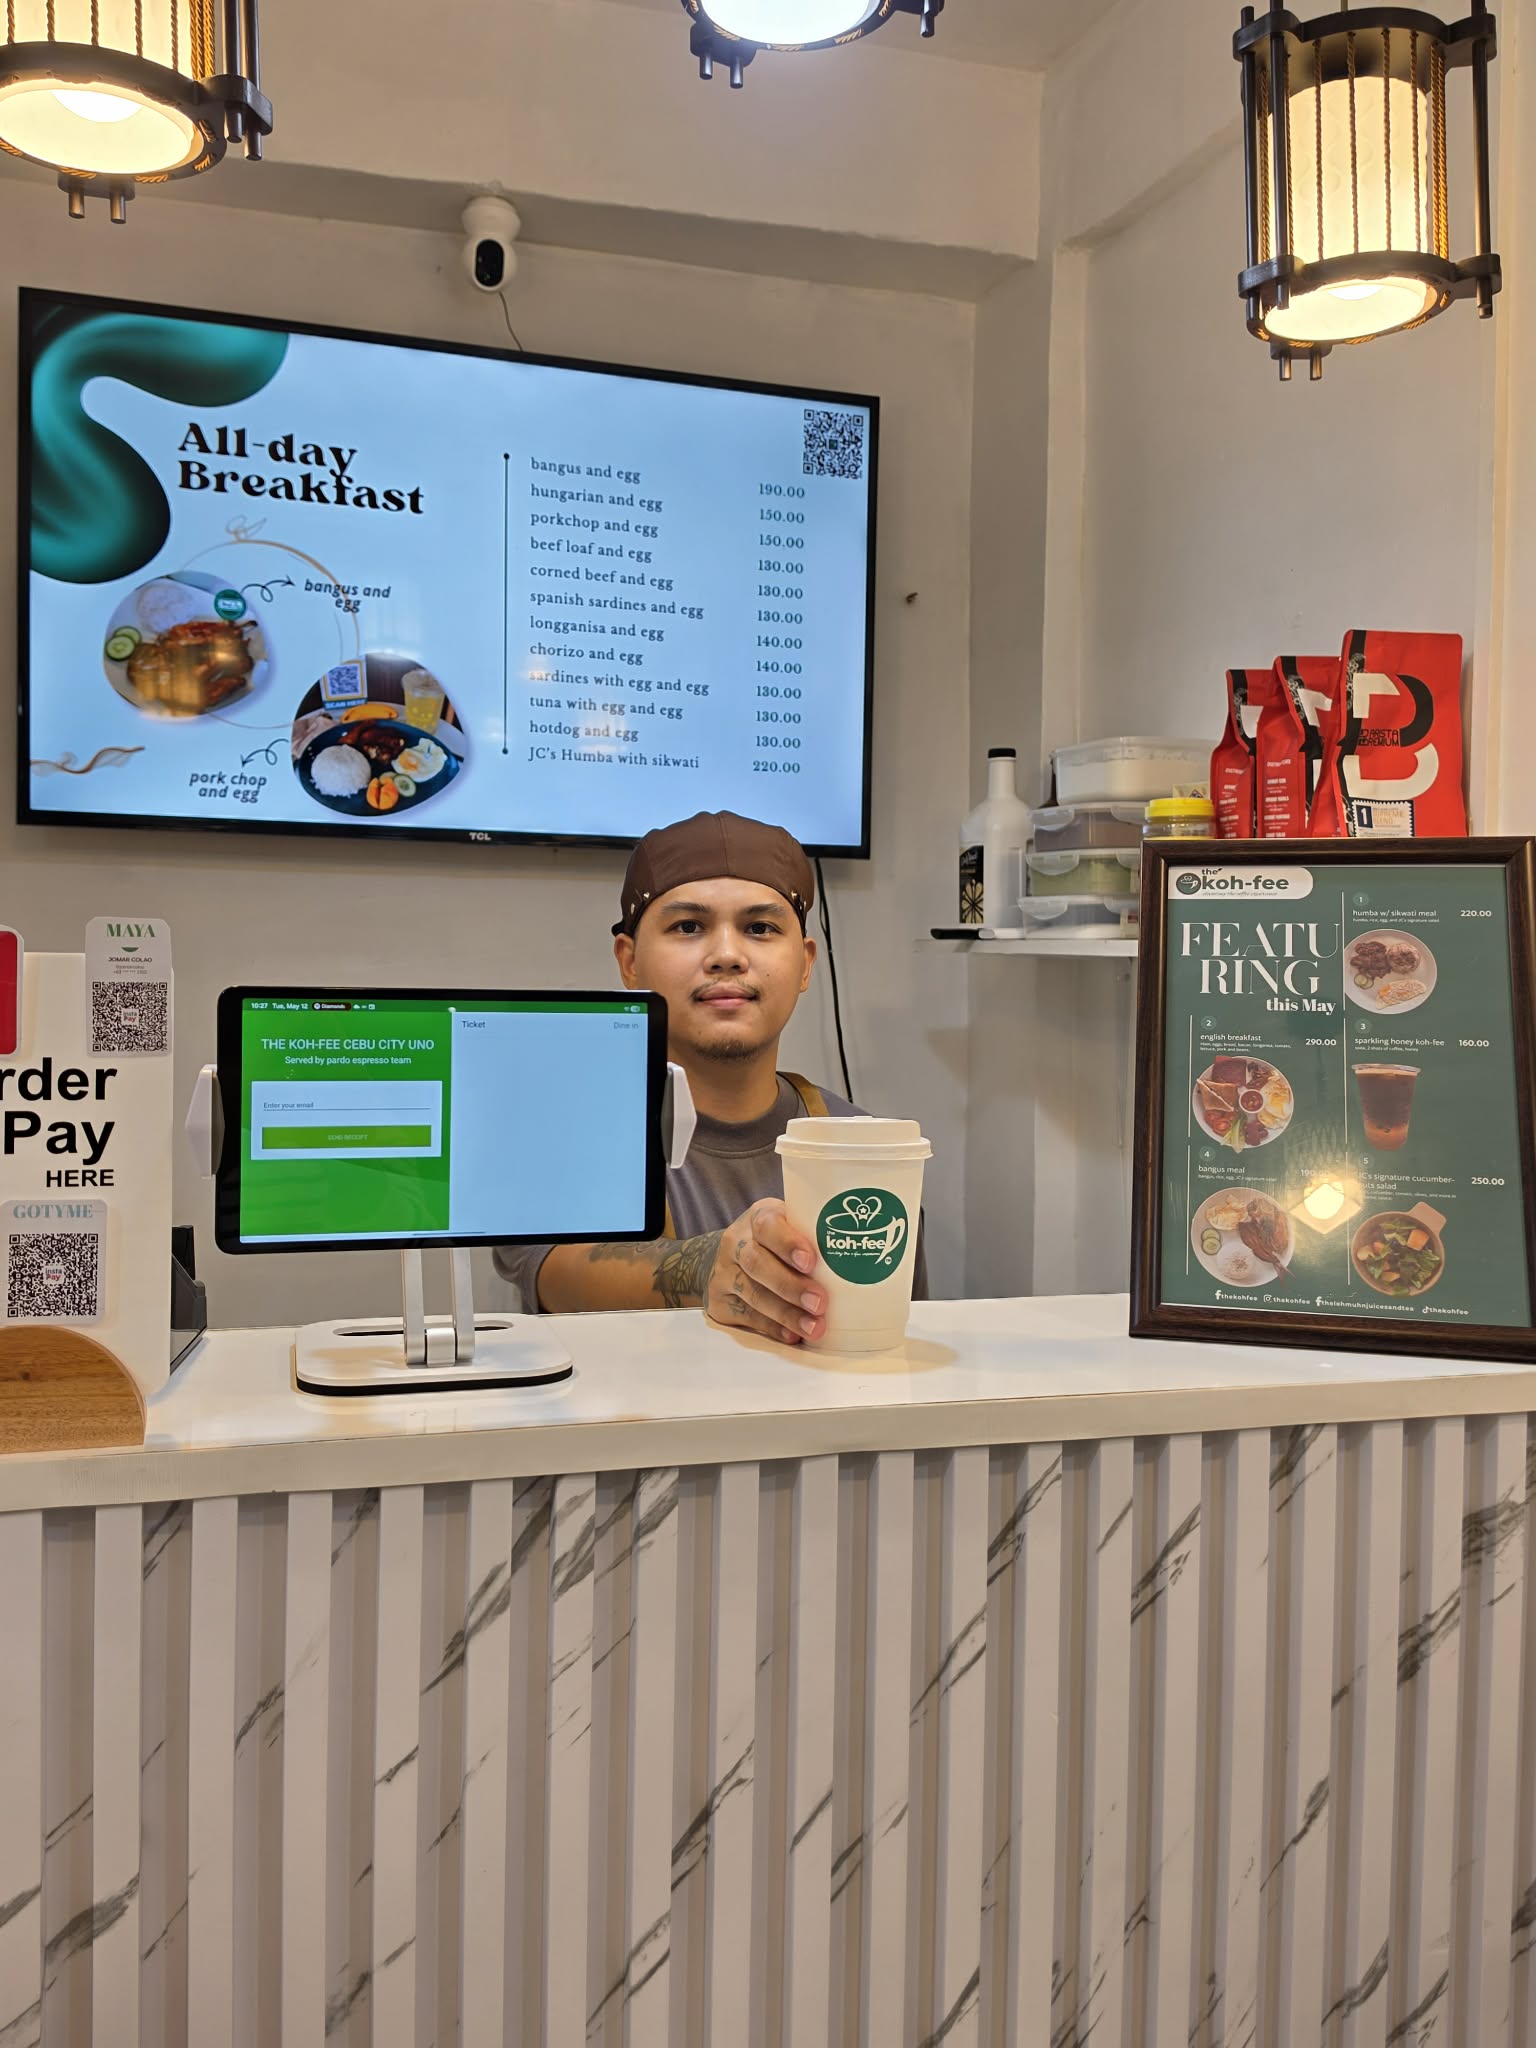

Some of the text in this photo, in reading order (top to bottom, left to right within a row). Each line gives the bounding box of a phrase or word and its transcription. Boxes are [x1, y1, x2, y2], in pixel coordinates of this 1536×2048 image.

[178, 422, 358, 478] All-day
[178, 460, 424, 514] Breakfast
[531, 457, 805, 498] bangus and egg 190.00
[531, 484, 804, 524] hungarian and egg 150.00
[531, 511, 804, 549] porkchop and egg 150.00
[531, 536, 803, 574] beef loaf and egg 130.00
[305, 578, 392, 598] bangus and
[531, 565, 803, 599] corned beef and egg 130.00
[335, 598, 361, 614] egg
[530, 591, 803, 625] spanish sardines and egg 130.00
[530, 616, 802, 650] longganisa and egg 140.00
[530, 642, 802, 675] chorizo and egg 140.00
[594, 672, 623, 687] with
[628, 678, 652, 692] egg
[656, 677, 682, 692] and
[686, 682, 710, 696] egg
[756, 685, 802, 700] 130.00
[530, 696, 801, 725] tuna with egg and egg 130.00
[530, 721, 801, 750] hotdog and egg 130.00
[528, 747, 800, 774] JC's Humba with sikwati 220.00
[189, 771, 267, 790] pork chop
[199, 785, 259, 803] and egg
[1361, 808, 1368, 824] 1
[469, 832, 491, 840] TCL
[1202, 875, 1289, 889] koh-fee
[106, 923, 155, 937] MAYA
[1181, 923, 1340, 959] FEATU
[1200, 959, 1320, 996] RING
[1266, 998, 1336, 1015] this May
[462, 1020, 639, 1029] Ticket Dine in
[262, 1039, 434, 1049] THE KOH-FEE CEBU CITY UNO
[1391, 1038, 1413, 1046] honey
[285, 1056, 313, 1064] Served
[315, 1056, 324, 1065] by
[327, 1056, 350, 1065] pardo
[352, 1057, 389, 1065] espresso
[4, 1111, 115, 1165] Pay
[46, 1169, 114, 1187] HERE
[1198, 1165, 1225, 1173] bangus
[1374, 1173, 1410, 1182] signature
[1412, 1175, 1455, 1183] cucumber-
[1471, 1177, 1505, 1185] 250.00
[13, 1204, 93, 1219] GOTYME
[826, 1235, 886, 1249] koh-fee
